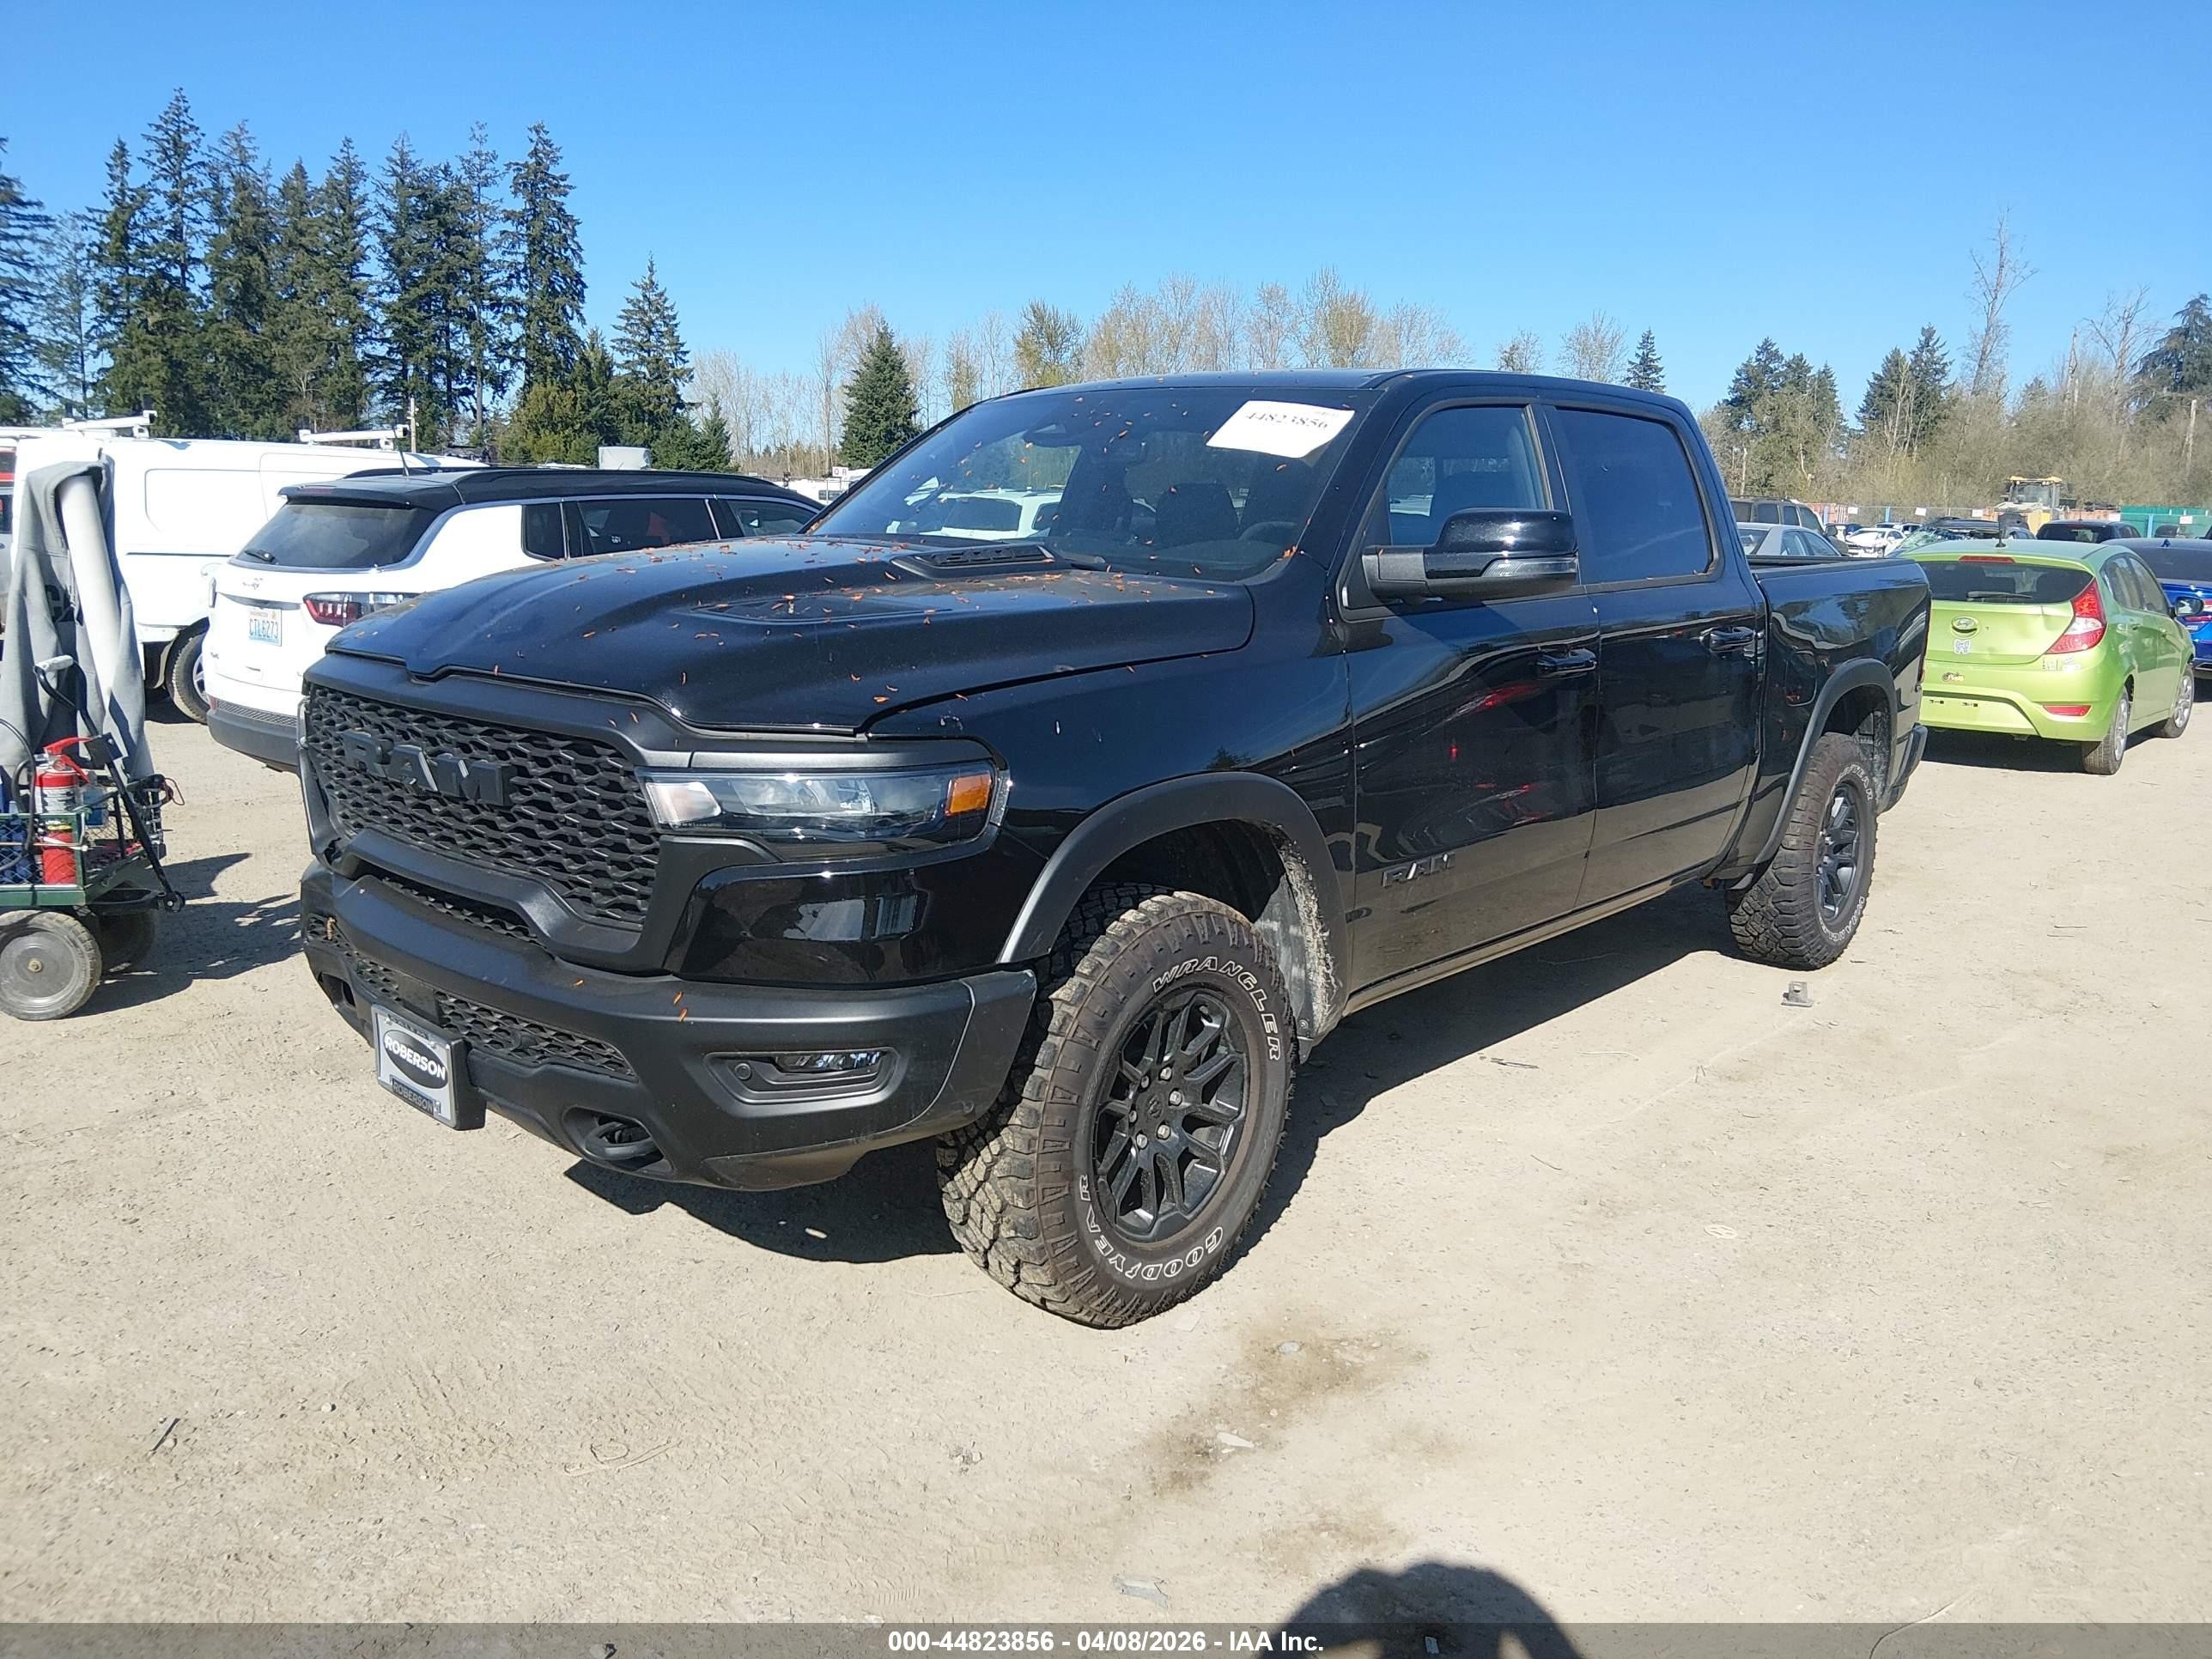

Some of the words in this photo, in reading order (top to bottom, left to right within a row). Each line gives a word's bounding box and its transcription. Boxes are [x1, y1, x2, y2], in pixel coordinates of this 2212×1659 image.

[343, 729, 514, 806] RAM
[1152, 956, 1282, 1062] WRANGLER
[384, 1035, 447, 1081] ROBERSON
[392, 1080, 434, 1115] ROBERSON
[1079, 1174, 1224, 1281] GOODYEAR
